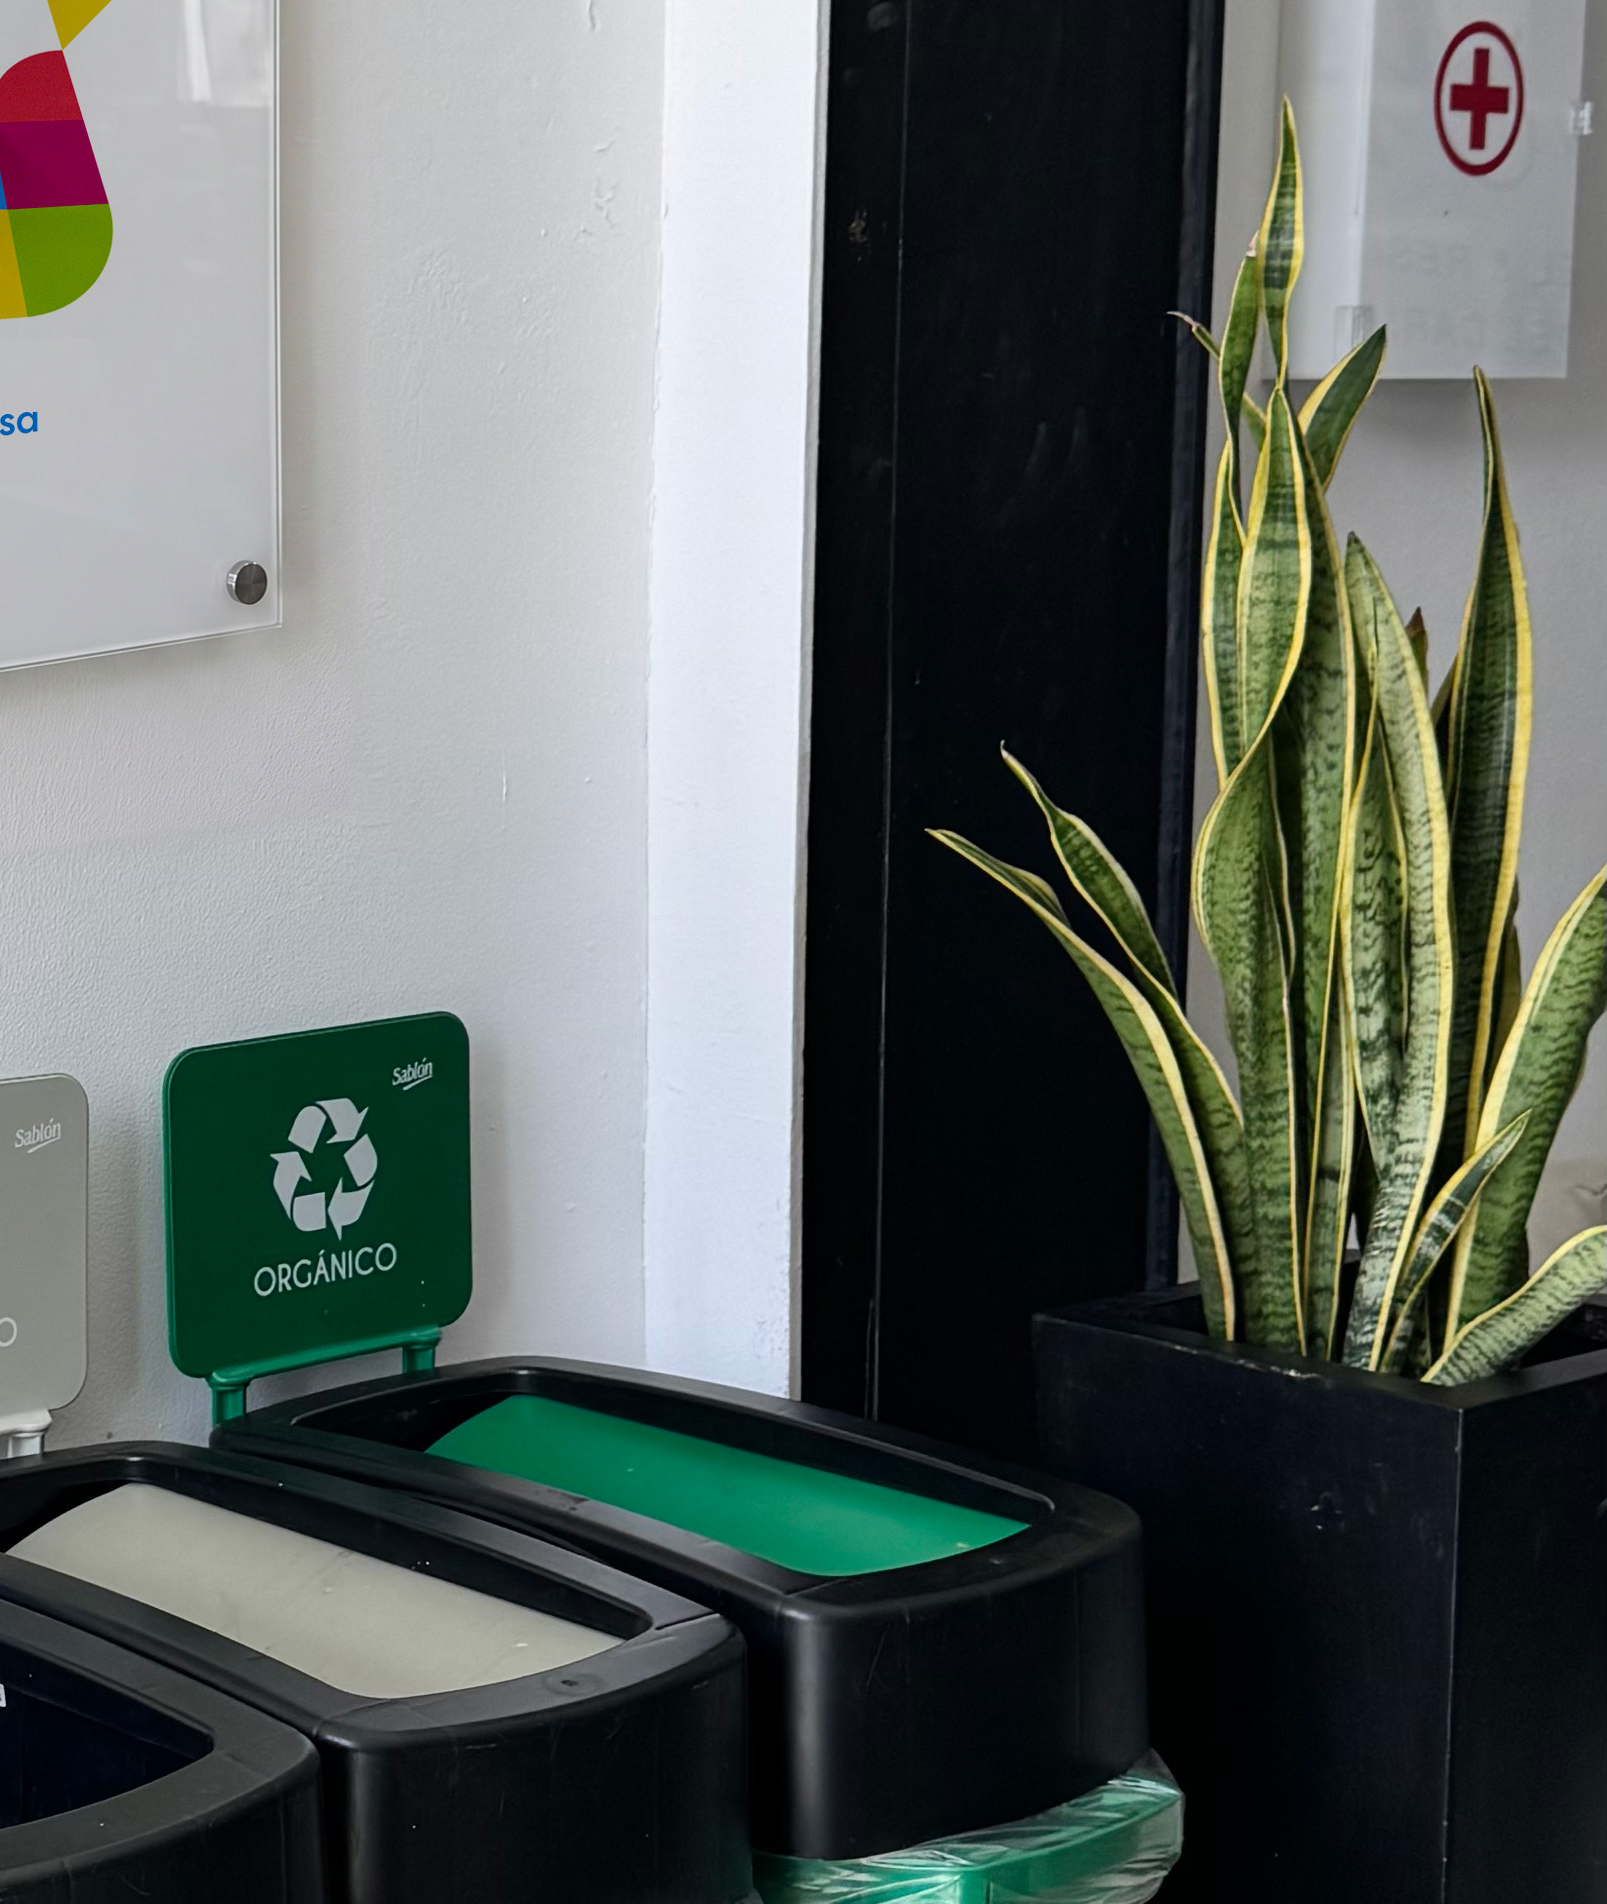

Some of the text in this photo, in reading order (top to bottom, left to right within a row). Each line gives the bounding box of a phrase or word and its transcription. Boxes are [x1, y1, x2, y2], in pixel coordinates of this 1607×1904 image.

[392, 1057, 433, 1086] Sablón
[15, 1118, 61, 1148] Sablón
[254, 1243, 396, 1296] ORGÁNICO
